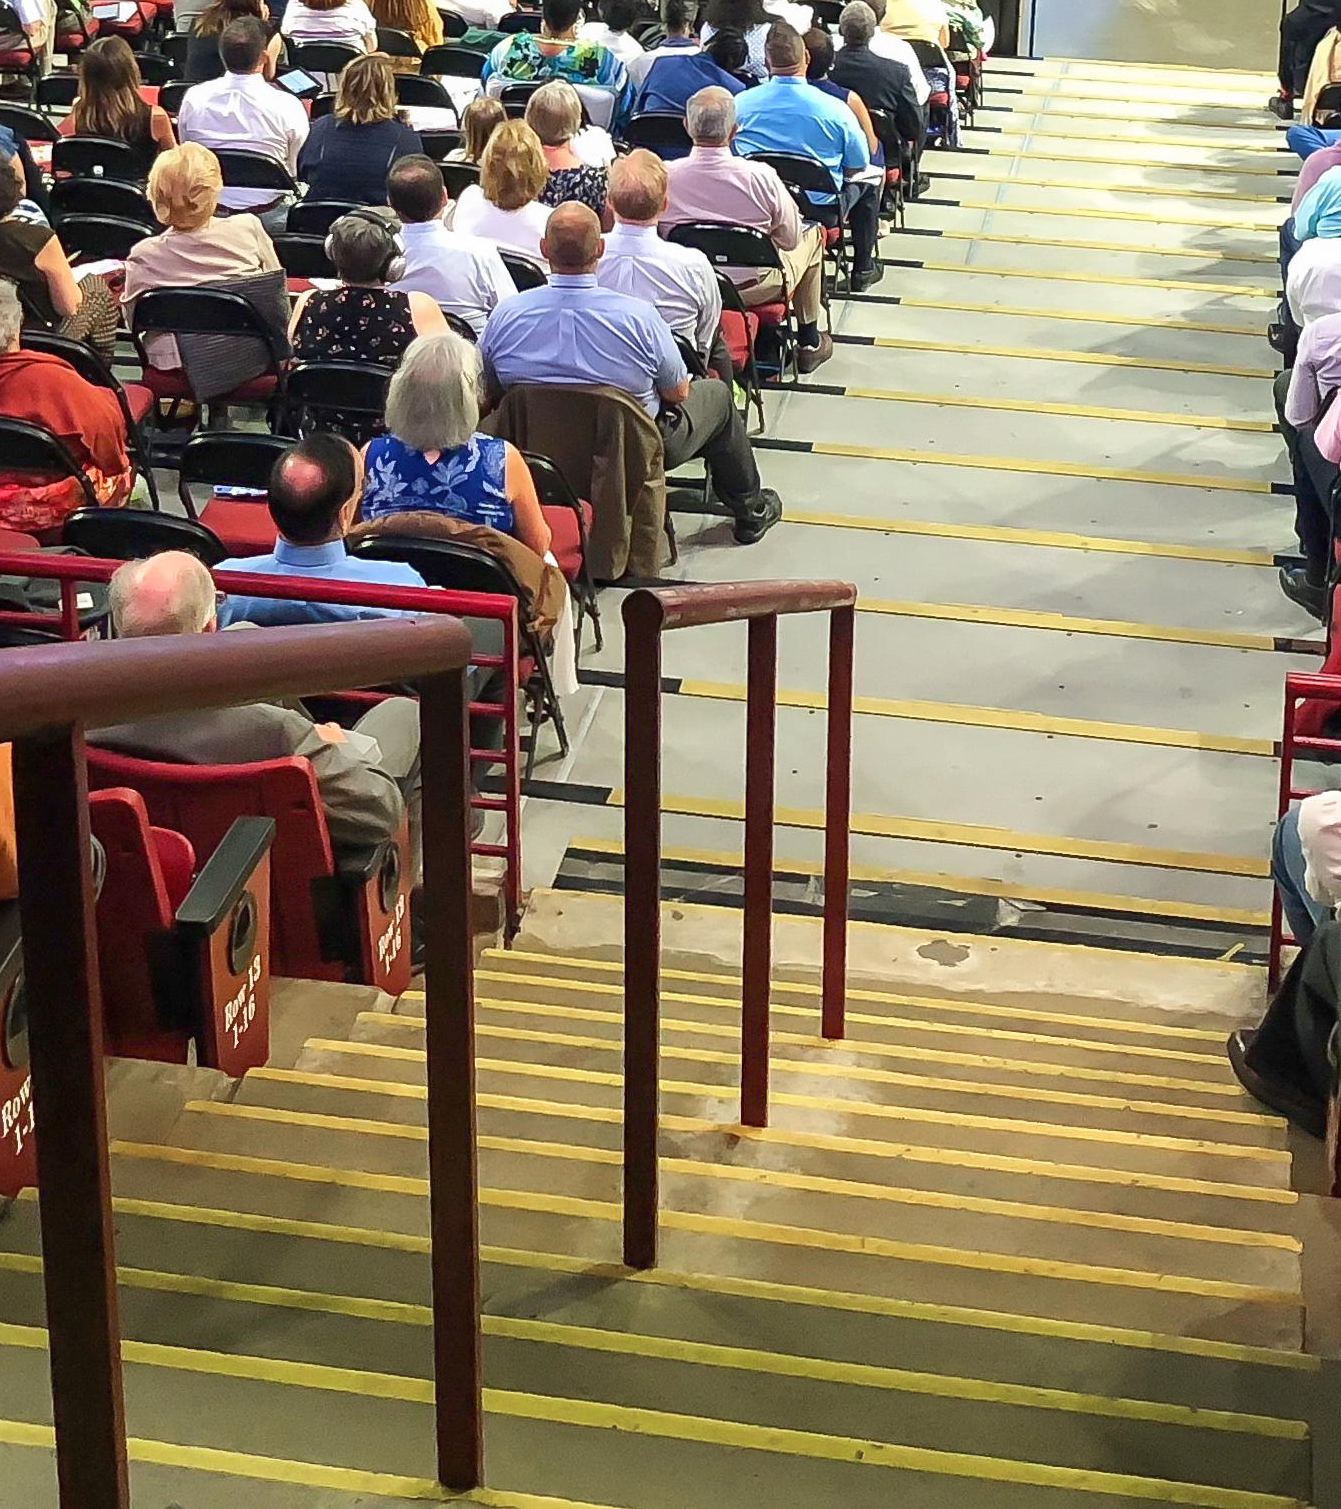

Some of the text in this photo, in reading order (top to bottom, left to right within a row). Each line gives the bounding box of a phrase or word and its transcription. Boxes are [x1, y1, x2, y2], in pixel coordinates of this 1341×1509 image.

[224, 984, 247, 1033] Row
[232, 993, 256, 1049] 1-16
[1, 1074, 32, 1139] Row
[14, 1101, 36, 1156] 1-1
